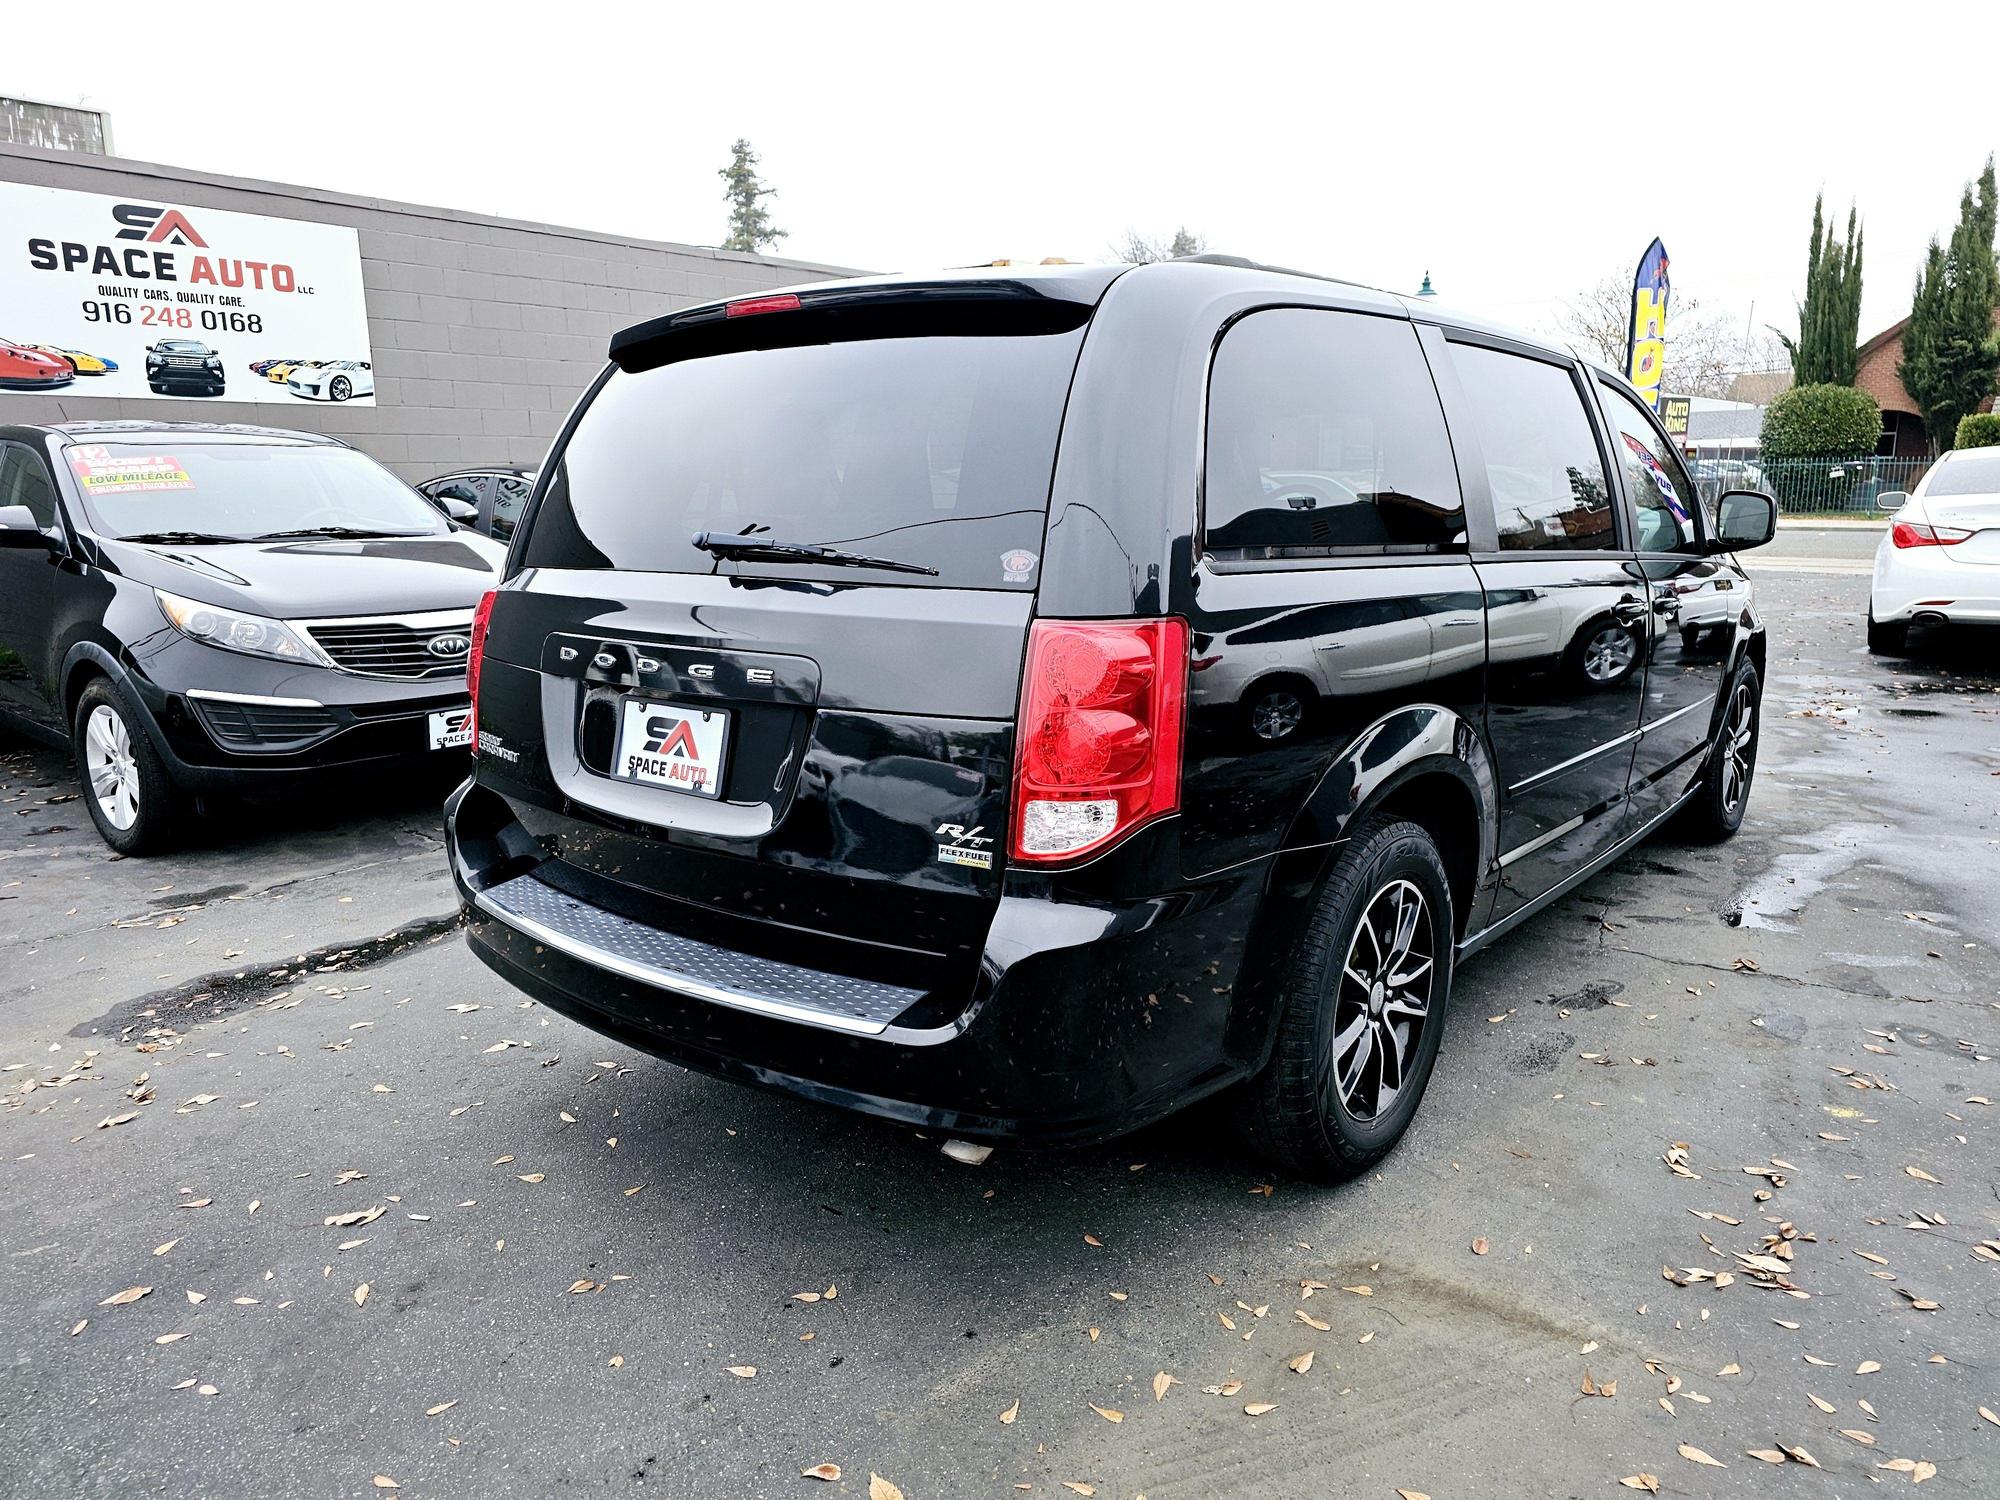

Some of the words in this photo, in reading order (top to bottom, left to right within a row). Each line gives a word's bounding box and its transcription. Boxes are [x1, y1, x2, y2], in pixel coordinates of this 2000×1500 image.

[28, 238, 177, 281] SPACE
[190, 255, 295, 293] AUTO
[298, 287, 314, 295] LLC
[98, 284, 138, 300] QUALITY
[144, 287, 173, 303] CARS.
[177, 291, 215, 306] QUALITY
[219, 294, 246, 308] CARE.
[82, 300, 131, 324] 916
[139, 305, 192, 329] 248
[201, 310, 263, 334] 0168
[1665, 400, 1688, 417] AUTO
[1665, 416, 1687, 433] KING
[89, 474, 118, 484] LOW
[122, 472, 182, 482] MILEAGE
[436, 639, 466, 653] KIA
[560, 646, 775, 685] DODGE
[436, 733, 466, 746] SPACE
[628, 755, 667, 777] SPACE
[669, 763, 707, 785] AUTO
[935, 823, 994, 848] R/T
